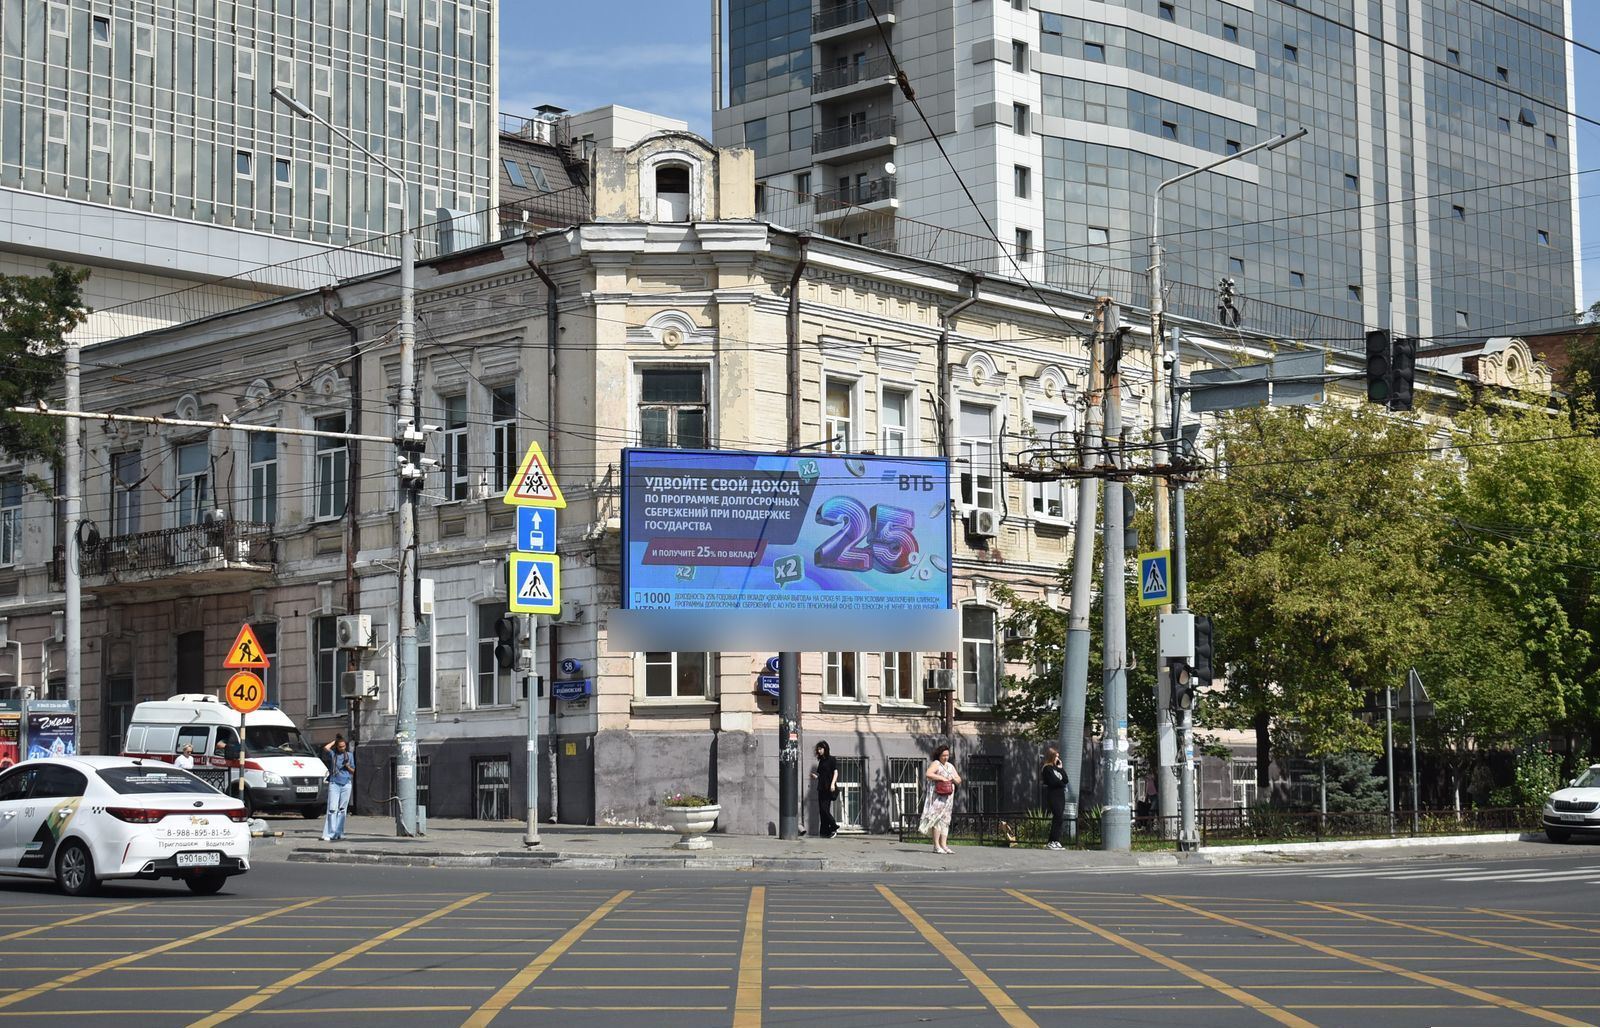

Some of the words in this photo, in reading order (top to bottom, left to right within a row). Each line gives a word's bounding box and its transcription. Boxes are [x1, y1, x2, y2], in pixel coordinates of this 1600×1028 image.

[644, 474, 708, 491] УДВОЙТЕ
[711, 476, 748, 492] СВОЙ
[751, 479, 800, 495] ДОХОД
[899, 474, 934, 491] ВТБ
[644, 494, 659, 503] ПО
[661, 495, 720, 505] ПРОГРАММЕ
[721, 496, 800, 507] ДОЛГОСРОЧНЫХ
[644, 506, 709, 517] СБЕРЕЖЕНИЙ
[710, 508, 730, 518] ПРИ
[731, 509, 791, 520] ПОДДЕРЖКЕ
[644, 520, 713, 532] ГОСУДАРСТВА
[658, 549, 696, 557] ПОЛУЧИТЕ
[697, 546, 717, 558] 25%
[728, 550, 758, 559] ВКЛАДУ
[643, 592, 671, 603] 1000
[564, 662, 574, 671] 58
[166, 828, 232, 837] 8-988-895-81-56
